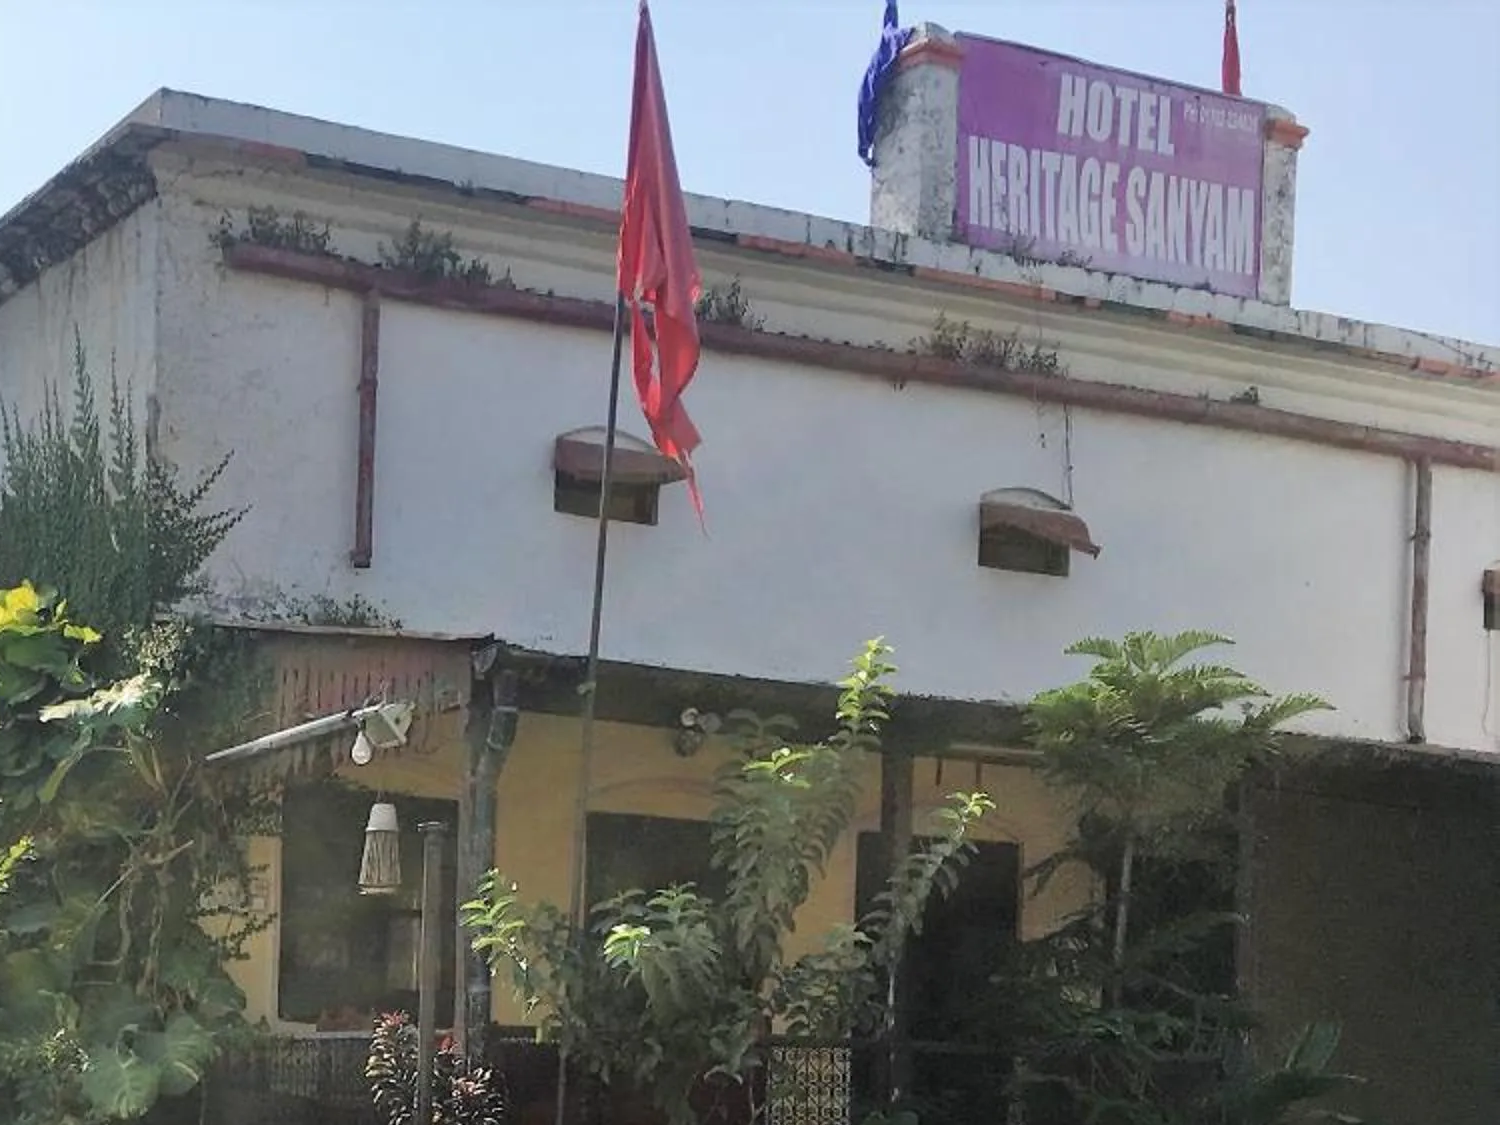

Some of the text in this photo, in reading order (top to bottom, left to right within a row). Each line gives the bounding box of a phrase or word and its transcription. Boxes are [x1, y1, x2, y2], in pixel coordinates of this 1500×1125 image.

[1057, 72, 1175, 156] HOTEL
[968, 134, 1255, 275] HERITAGE SANYAM
